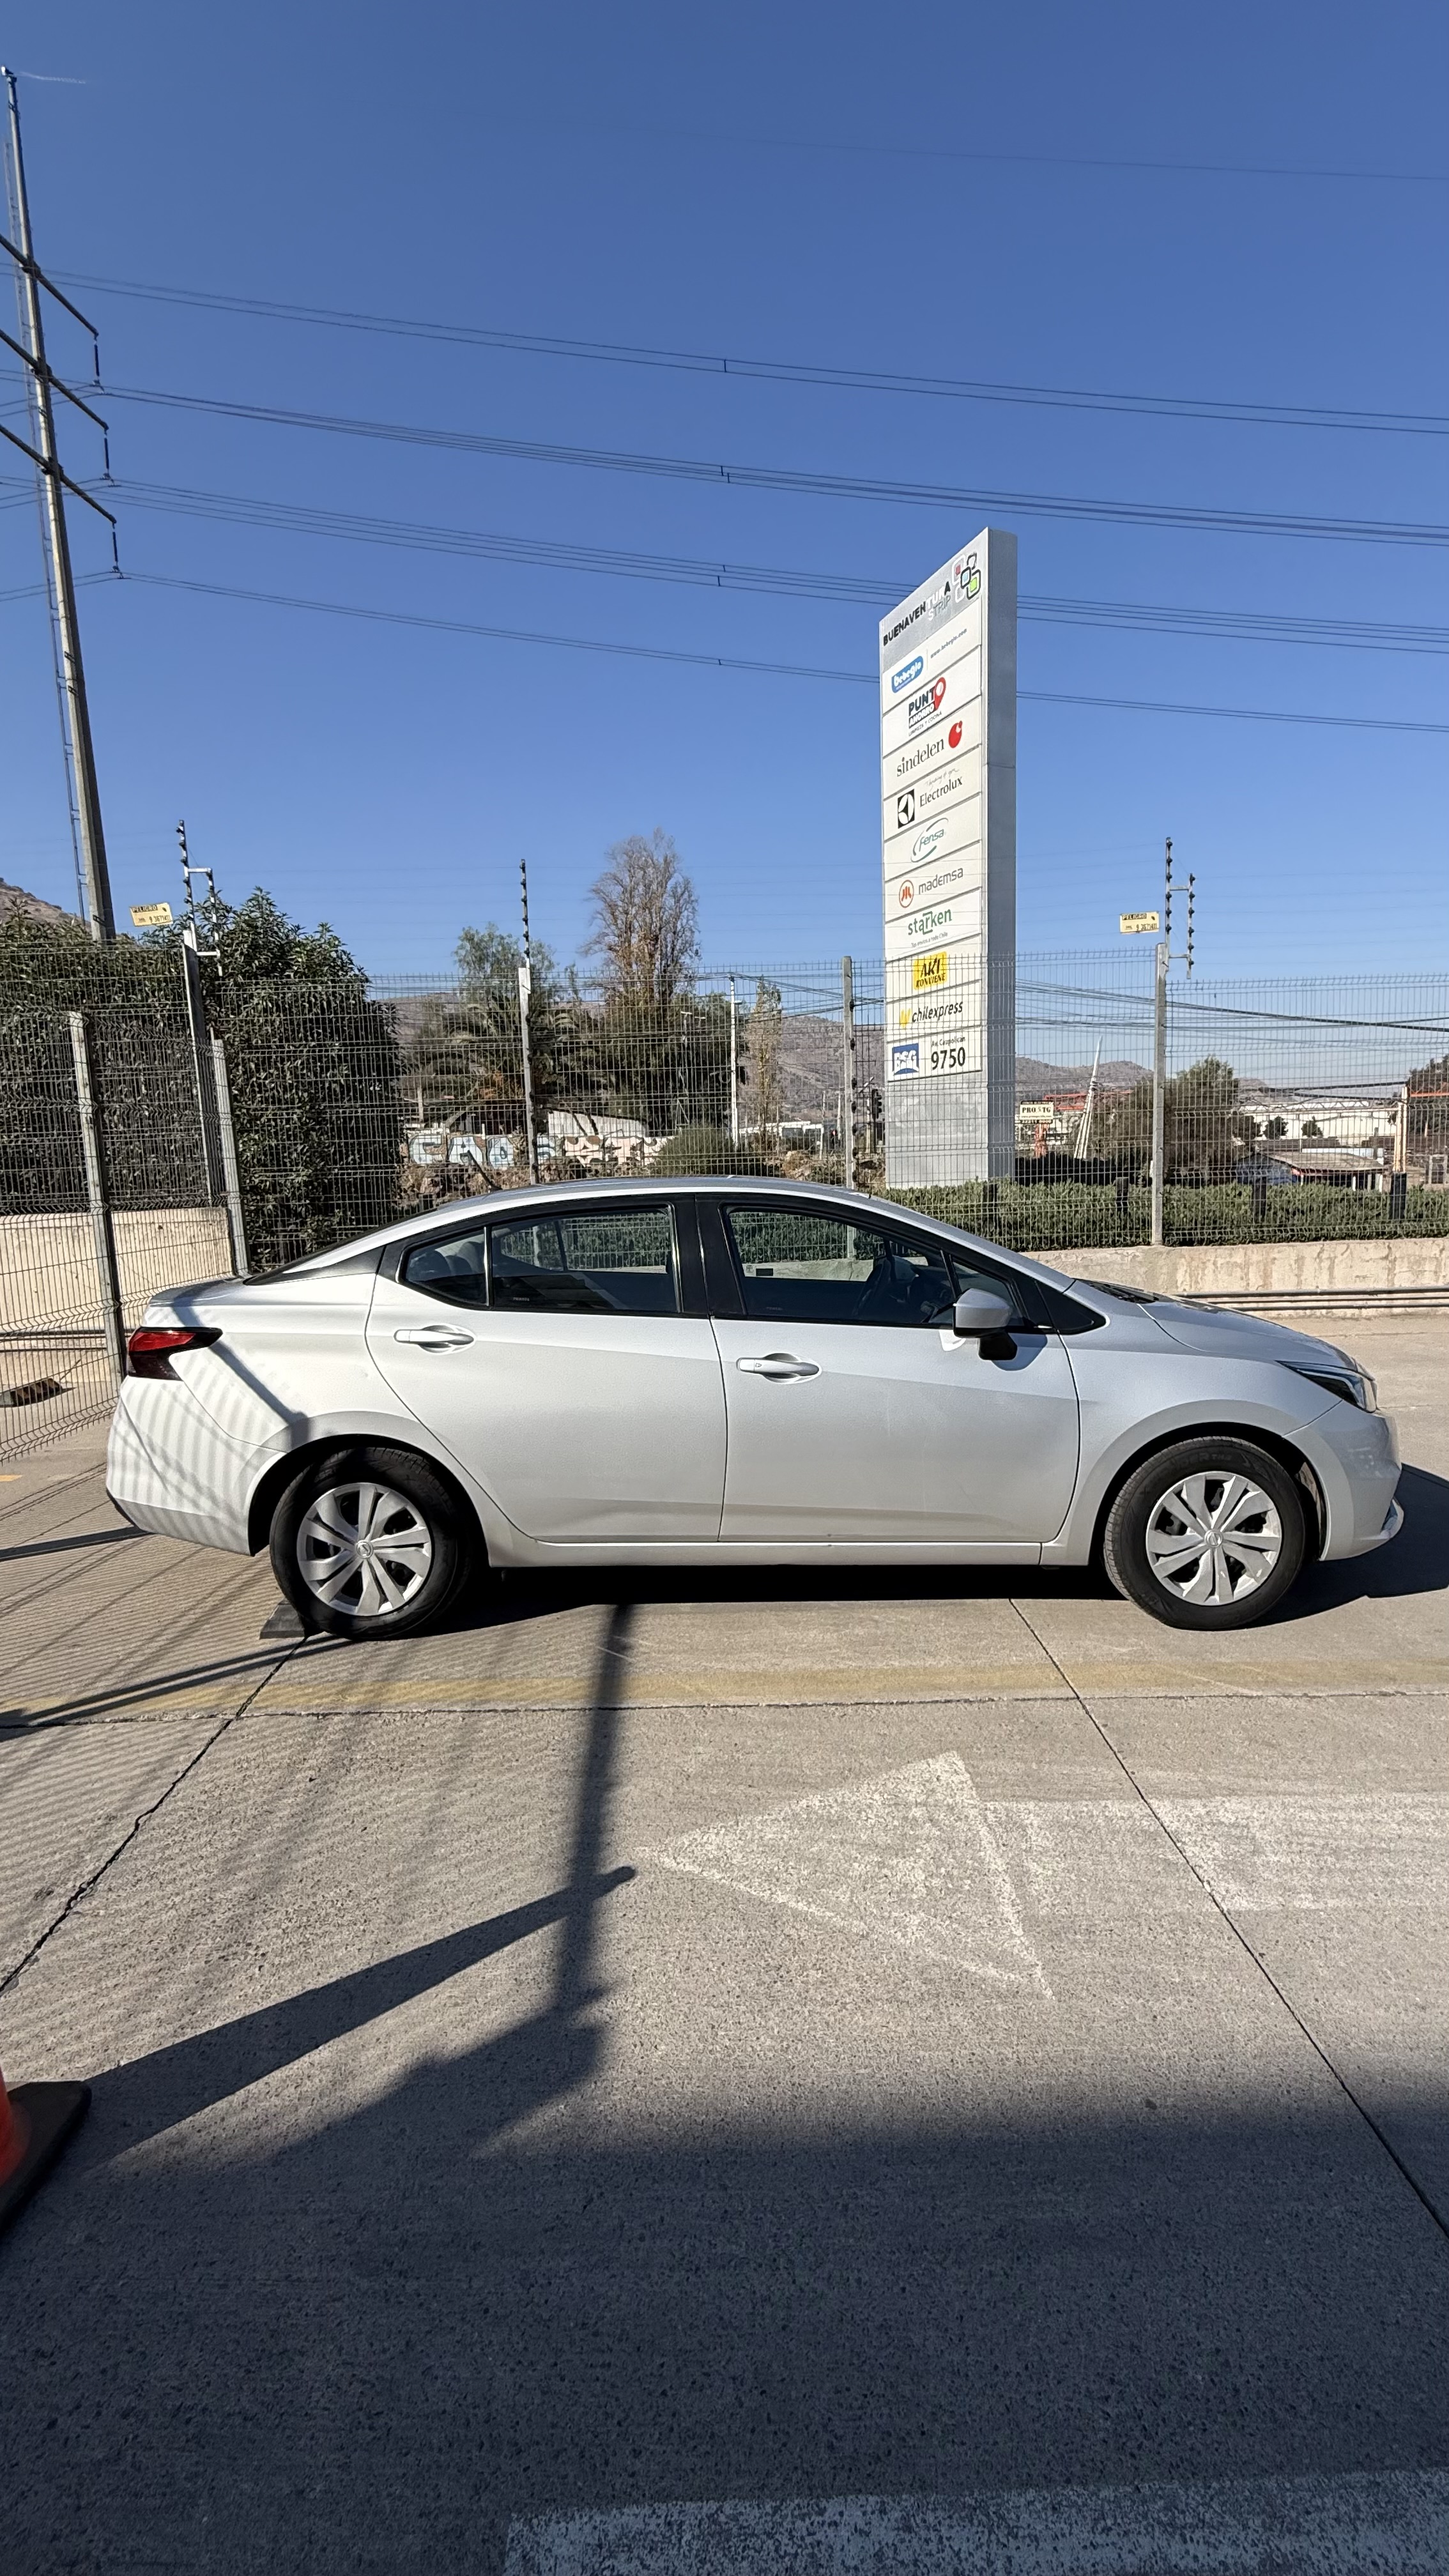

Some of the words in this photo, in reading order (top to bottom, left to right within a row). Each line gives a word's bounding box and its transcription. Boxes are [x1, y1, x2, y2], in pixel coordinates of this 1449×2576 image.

[884, 581, 951, 647] BUENAVENTURA
[928, 595, 951, 620] STRIP
[897, 739, 944, 777] sindelen
[920, 776, 963, 808] Electrolux
[919, 868, 963, 894] mademsa
[908, 909, 952, 935] starken
[921, 957, 940, 977] AKI
[912, 1001, 963, 1022] chilexpress
[931, 1046, 965, 1071] 9750
